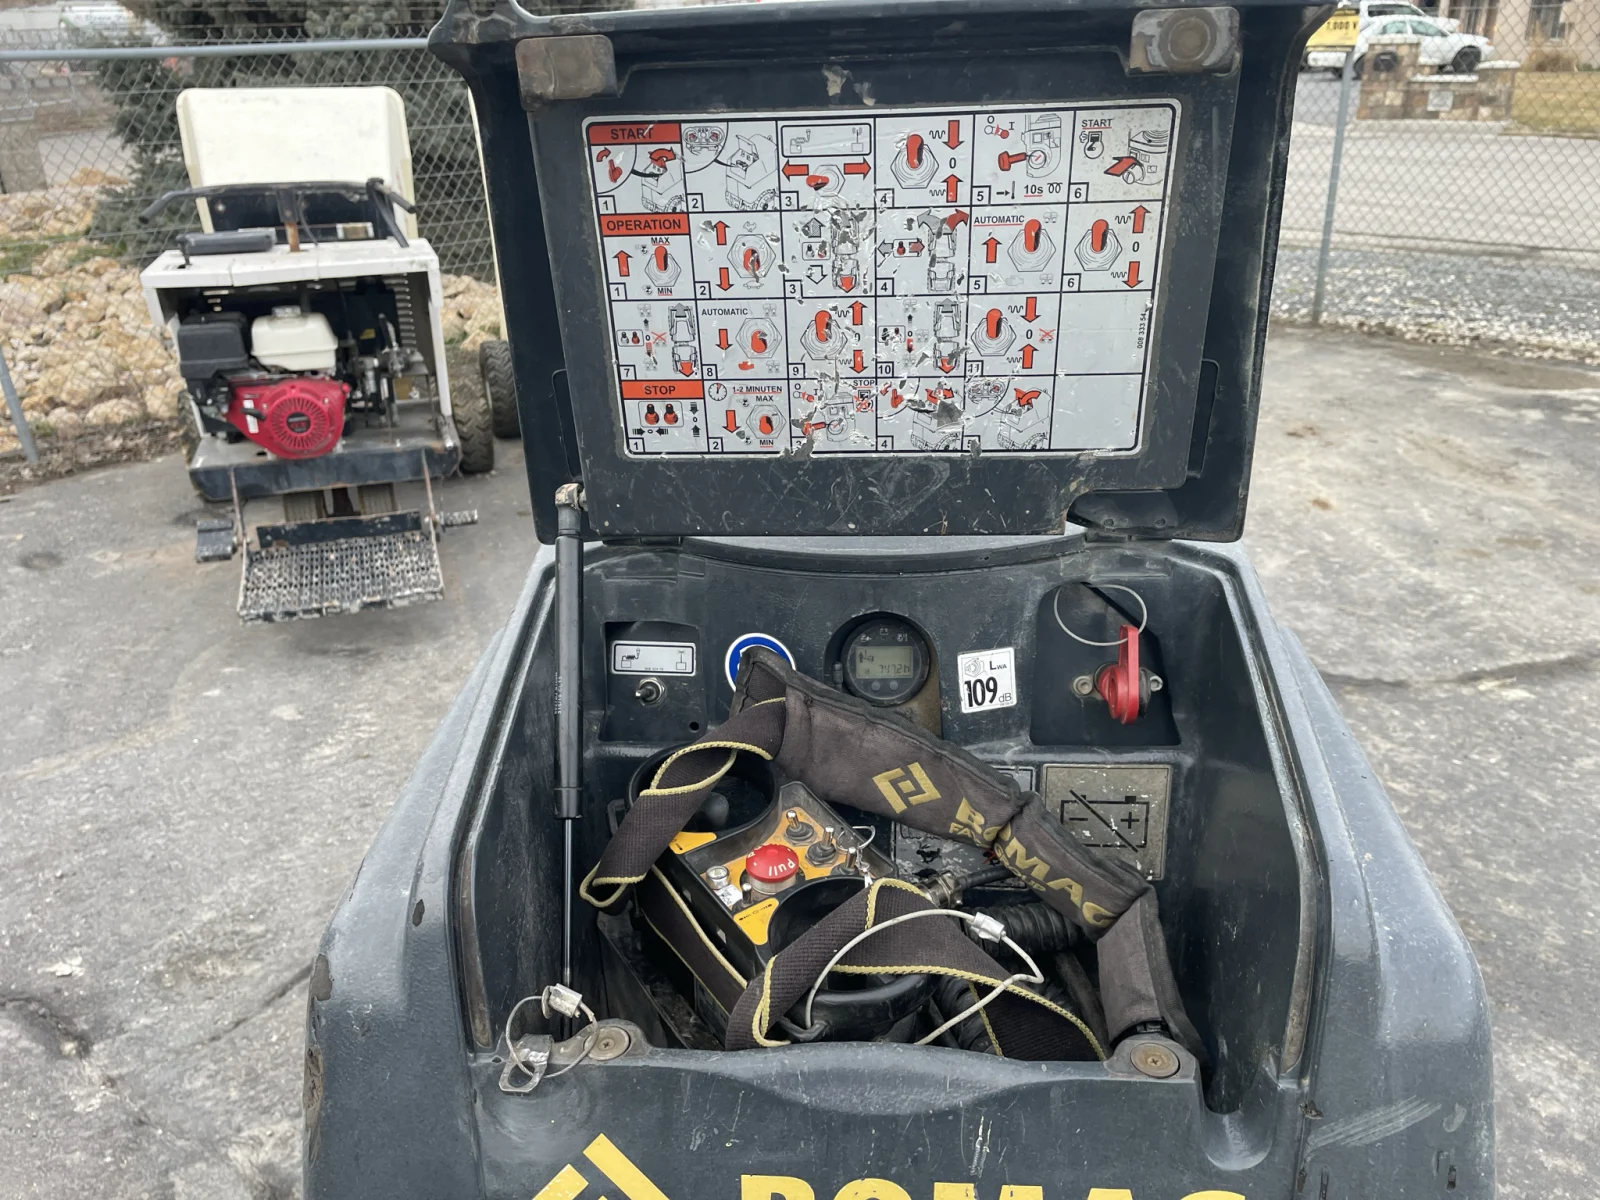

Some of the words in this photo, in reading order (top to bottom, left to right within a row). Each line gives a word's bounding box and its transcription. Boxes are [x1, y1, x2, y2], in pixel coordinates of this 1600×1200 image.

[1081, 118, 1112, 128] START
[610, 128, 653, 140] START
[1024, 184, 1043, 195] 10s
[1074, 188, 1082, 199] 6
[785, 196, 792, 207] 3
[880, 194, 888, 205] 4
[976, 191, 984, 202] 5
[603, 201, 609, 211] 1
[691, 198, 699, 209] 2
[973, 215, 1025, 224] AUTOMATIC
[606, 219, 681, 231] OPERATION
[651, 236, 670, 244] MAX
[880, 282, 889, 292] 4
[973, 280, 981, 290] 5
[1067, 278, 1075, 288] 6
[614, 287, 620, 297] 1
[657, 287, 673, 295] MIN
[699, 286, 707, 296] 2
[789, 284, 797, 294] 3
[701, 308, 748, 317] AUTOMATIC
[624, 368, 631, 378] 7
[706, 367, 713, 377] 8
[792, 366, 799, 376] 9
[878, 365, 891, 375] 10
[644, 385, 676, 396] STOP
[747, 385, 782, 393] MINUTEN
[633, 441, 639, 451] 1
[712, 441, 720, 451] 2
[881, 439, 888, 449] 4
[964, 676, 998, 708] 109
[998, 692, 1012, 703] dB
